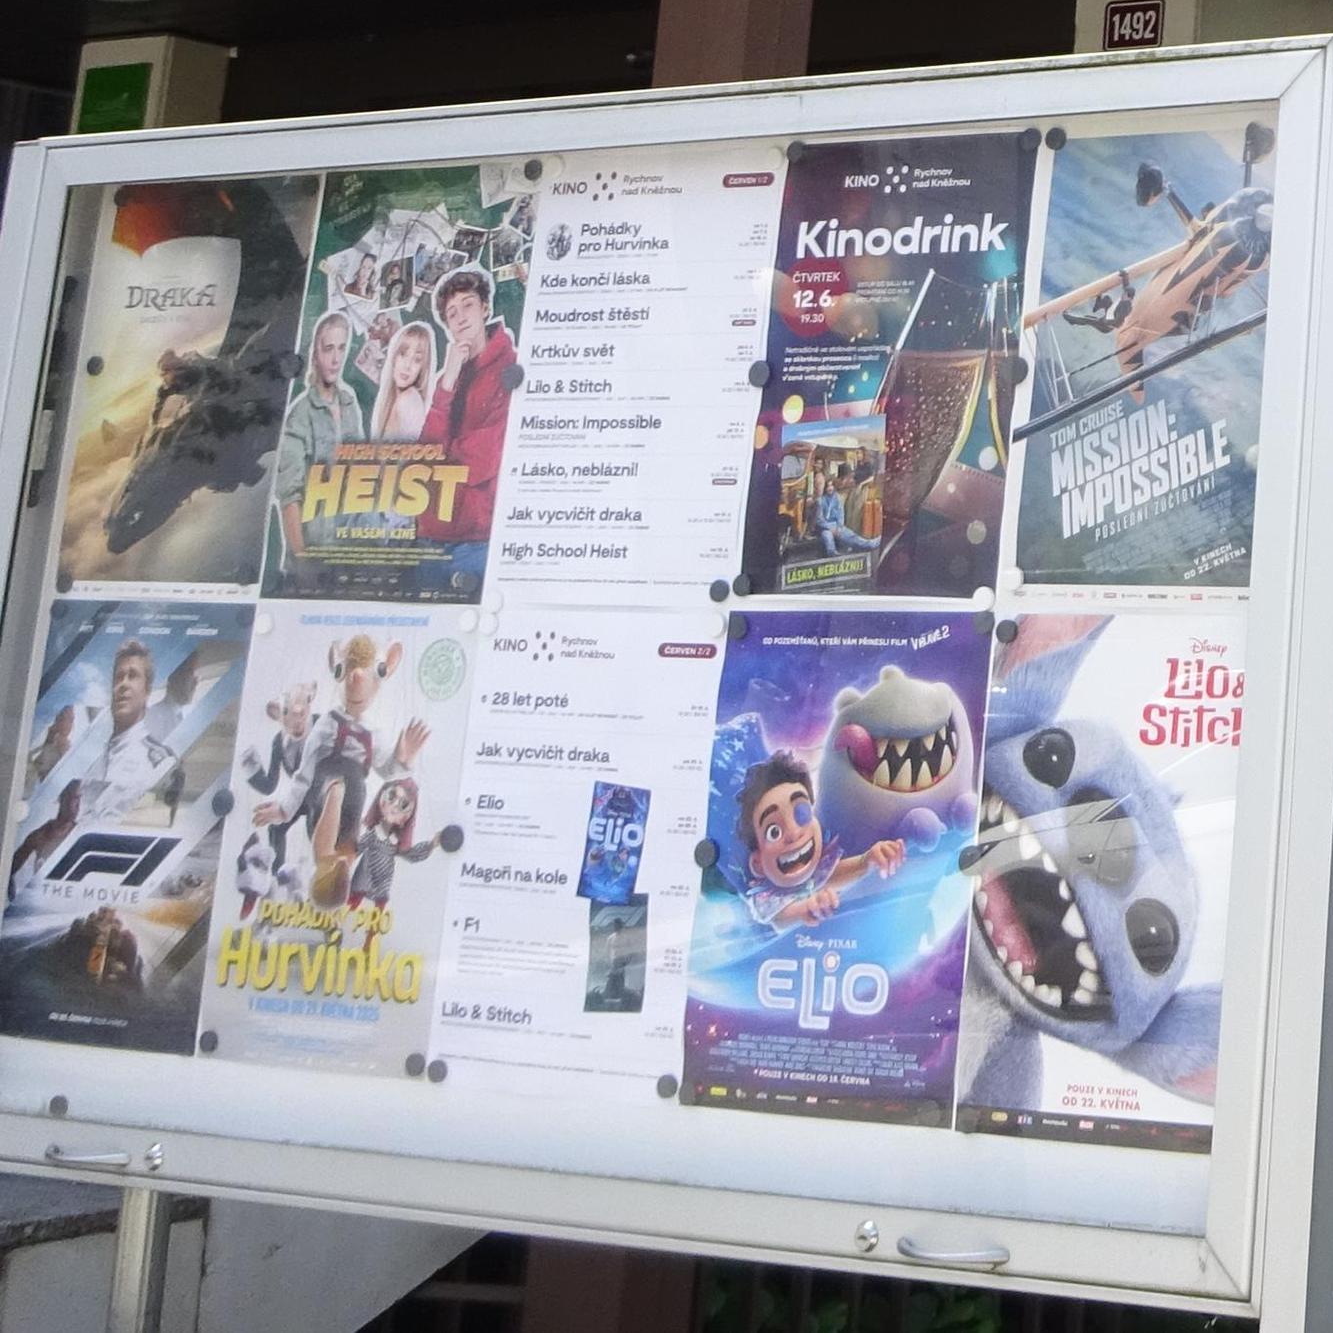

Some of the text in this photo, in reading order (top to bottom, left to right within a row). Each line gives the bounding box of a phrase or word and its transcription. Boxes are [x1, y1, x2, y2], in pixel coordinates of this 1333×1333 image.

[1112, 8, 1156, 42] 1492
[553, 174, 663, 195] KINO Rychnov
[845, 168, 952, 187] KINO Rychnov
[621, 184, 682, 196] nad Kněžnou
[581, 222, 641, 238] Pohádky
[796, 213, 1008, 258] Kinodrink
[578, 237, 669, 254] pro Hurvínka
[541, 272, 650, 288] Kde končí láska
[792, 269, 840, 283] ČTVRTEK
[125, 284, 216, 311] DRAKA
[535, 307, 650, 323] Moudrost štěstí
[800, 313, 824, 323] 19.30
[531, 344, 615, 358] Krtkův svět
[526, 379, 612, 393] Lilo & Stitch
[521, 415, 662, 432] Mission: Impossible
[1050, 400, 1124, 450] TOM CRUISE
[1052, 399, 1178, 497] MISSION:
[521, 462, 638, 478] Lásko, neblázni!
[1061, 419, 1230, 539] IMPOSSIBLE
[301, 464, 469, 523] HEIST
[508, 507, 642, 524] Jak vycvičit draka
[502, 543, 628, 560] High School Heist
[494, 636, 598, 651] KINO Rychnov
[1189, 637, 1227, 657] Disney
[561, 649, 576, 658] nad
[1164, 658, 1230, 699] Lilo
[492, 692, 569, 709] 28 let poté
[476, 742, 610, 763] Jak vycvičit draka
[477, 795, 504, 810] Elio
[46, 833, 183, 887] F1
[461, 863, 567, 885] Magoři na kole
[42, 883, 140, 905] THE MOVIE
[464, 918, 480, 933] F1
[217, 924, 423, 1004] Hurvínka
[441, 1002, 532, 1025] Lilo & Stitch
[1067, 1084, 1094, 1095] POUZE
[1106, 1087, 1138, 1097] KINECH
[1062, 1096, 1141, 1111] OD 22. KVĚTNA
